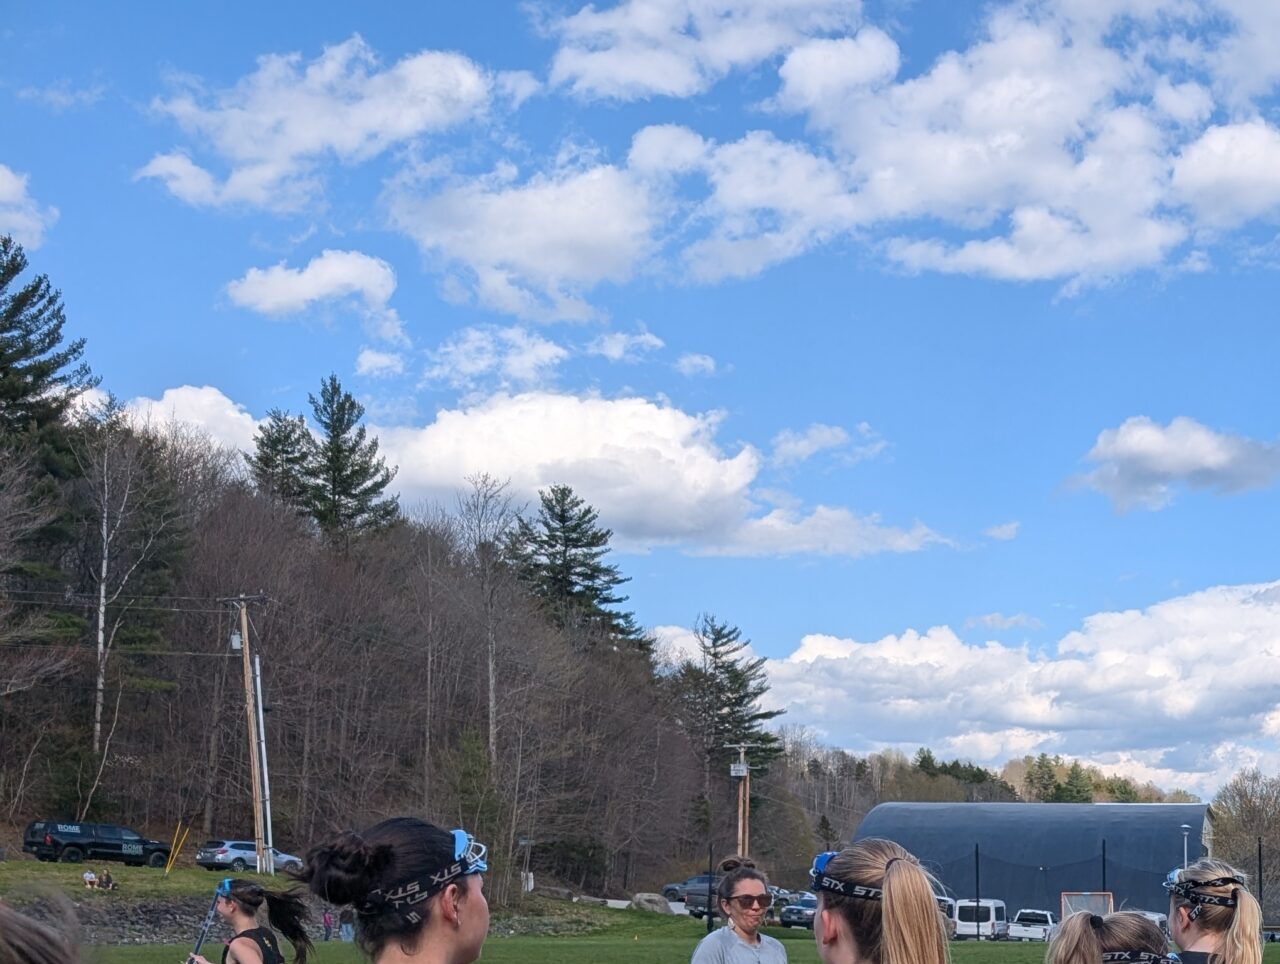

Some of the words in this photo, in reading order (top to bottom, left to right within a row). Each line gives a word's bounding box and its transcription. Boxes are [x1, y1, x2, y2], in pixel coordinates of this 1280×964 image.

[822, 876, 845, 891] STX
[853, 886, 883, 897] ST
[1103, 951, 1131, 960] STX
